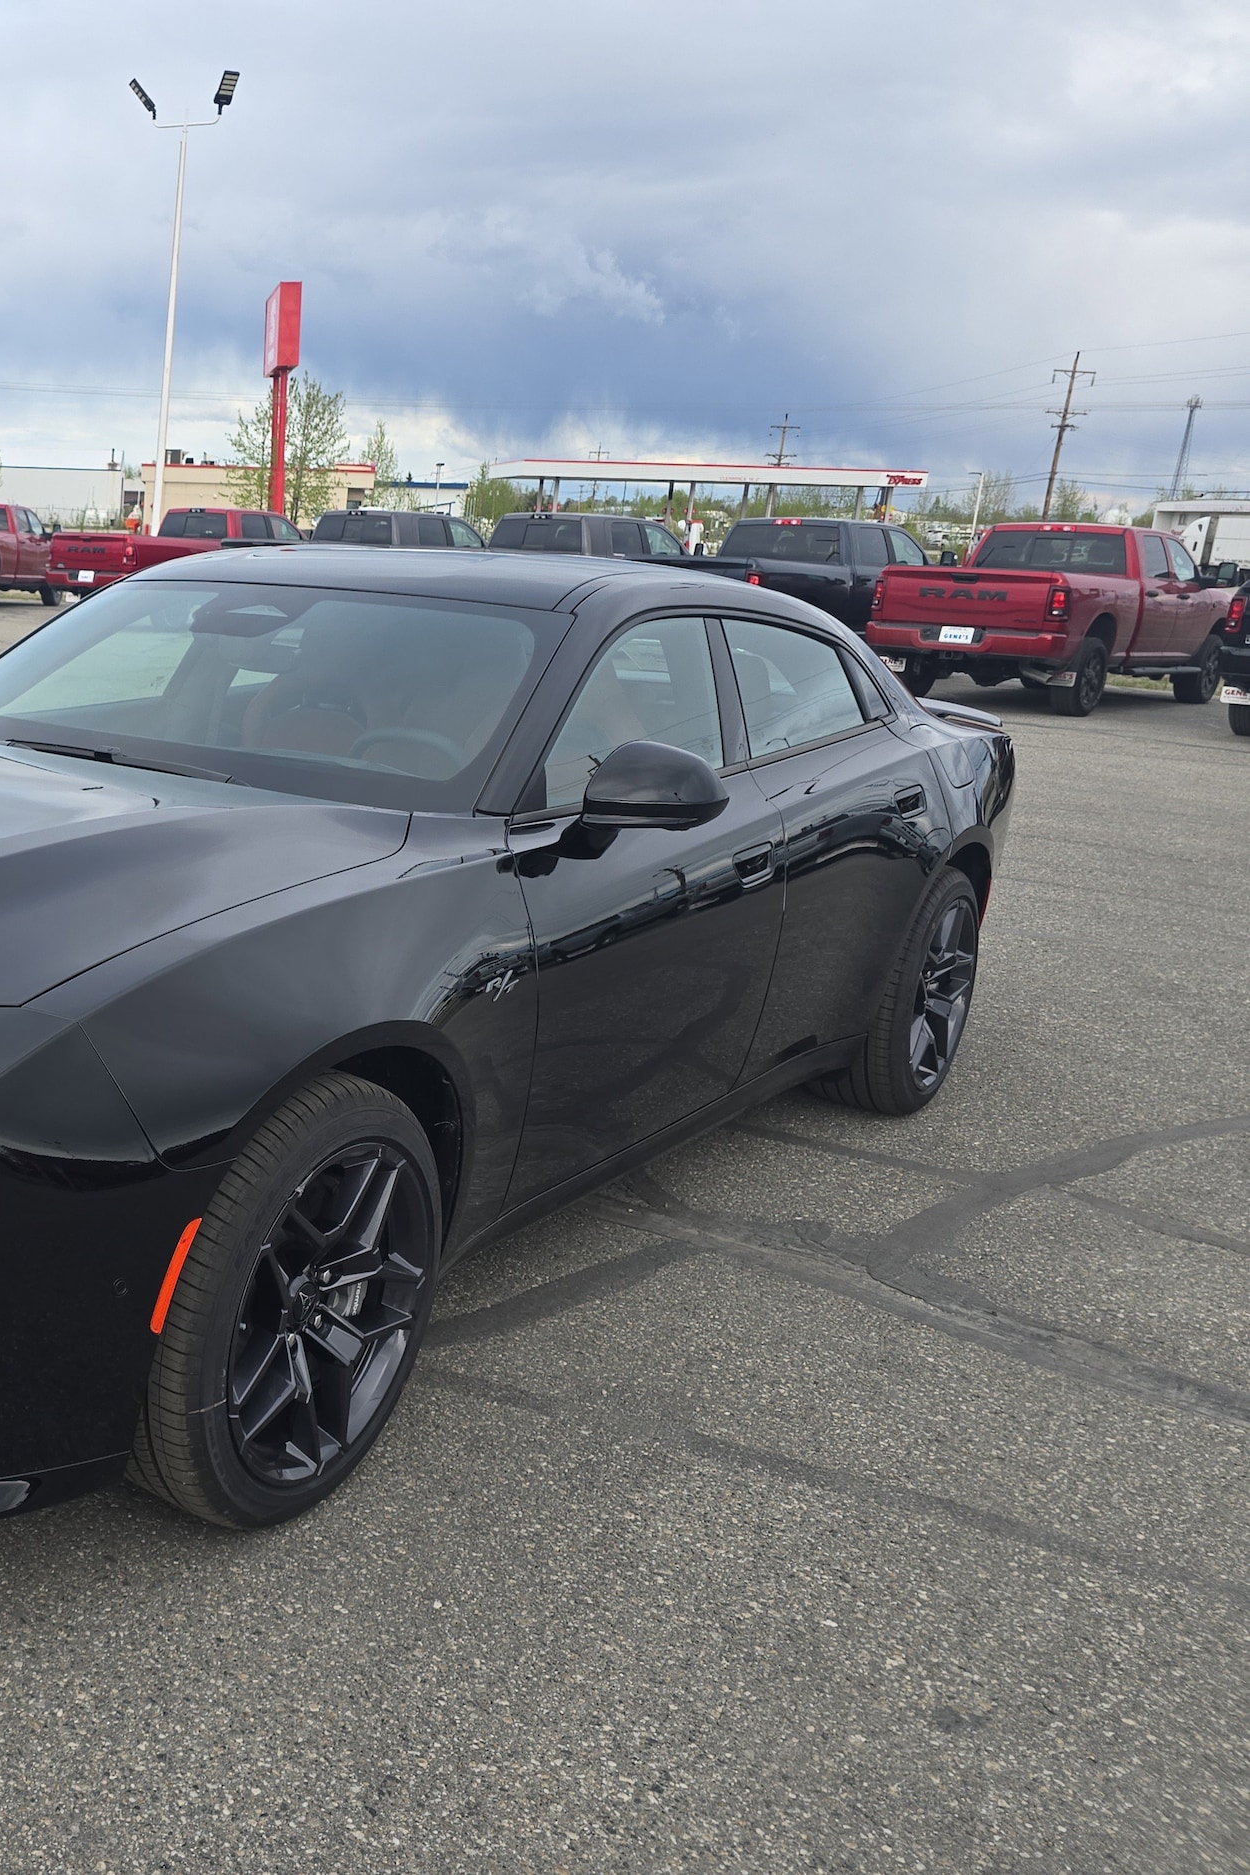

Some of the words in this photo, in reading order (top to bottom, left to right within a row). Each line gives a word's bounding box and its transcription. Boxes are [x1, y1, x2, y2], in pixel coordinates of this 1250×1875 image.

[68, 546, 106, 554] RAM
[919, 586, 1008, 603] RAM
[485, 969, 520, 1002] R/T
